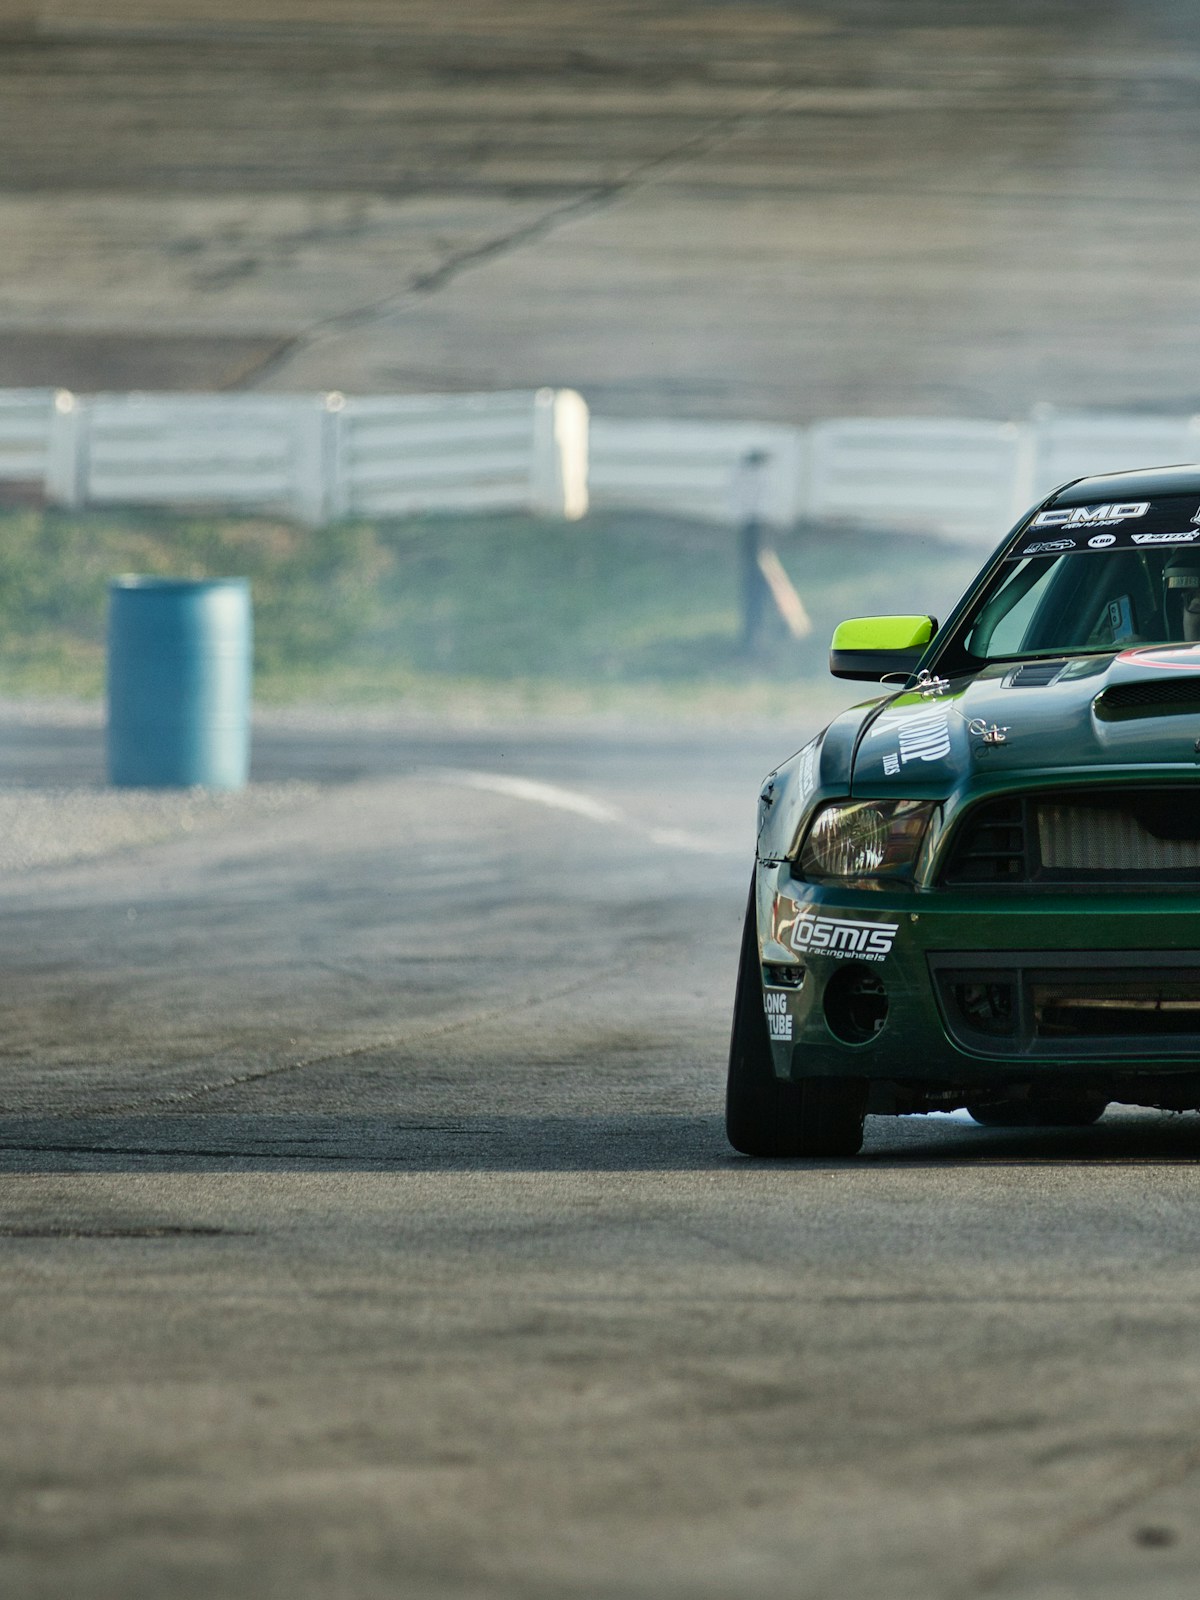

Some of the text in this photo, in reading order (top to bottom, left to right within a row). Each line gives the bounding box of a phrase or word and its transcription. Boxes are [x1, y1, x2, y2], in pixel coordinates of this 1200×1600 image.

[790, 913, 899, 954] COSMIS
[763, 993, 787, 1014] LONG
[768, 1014, 793, 1035] TUBE
